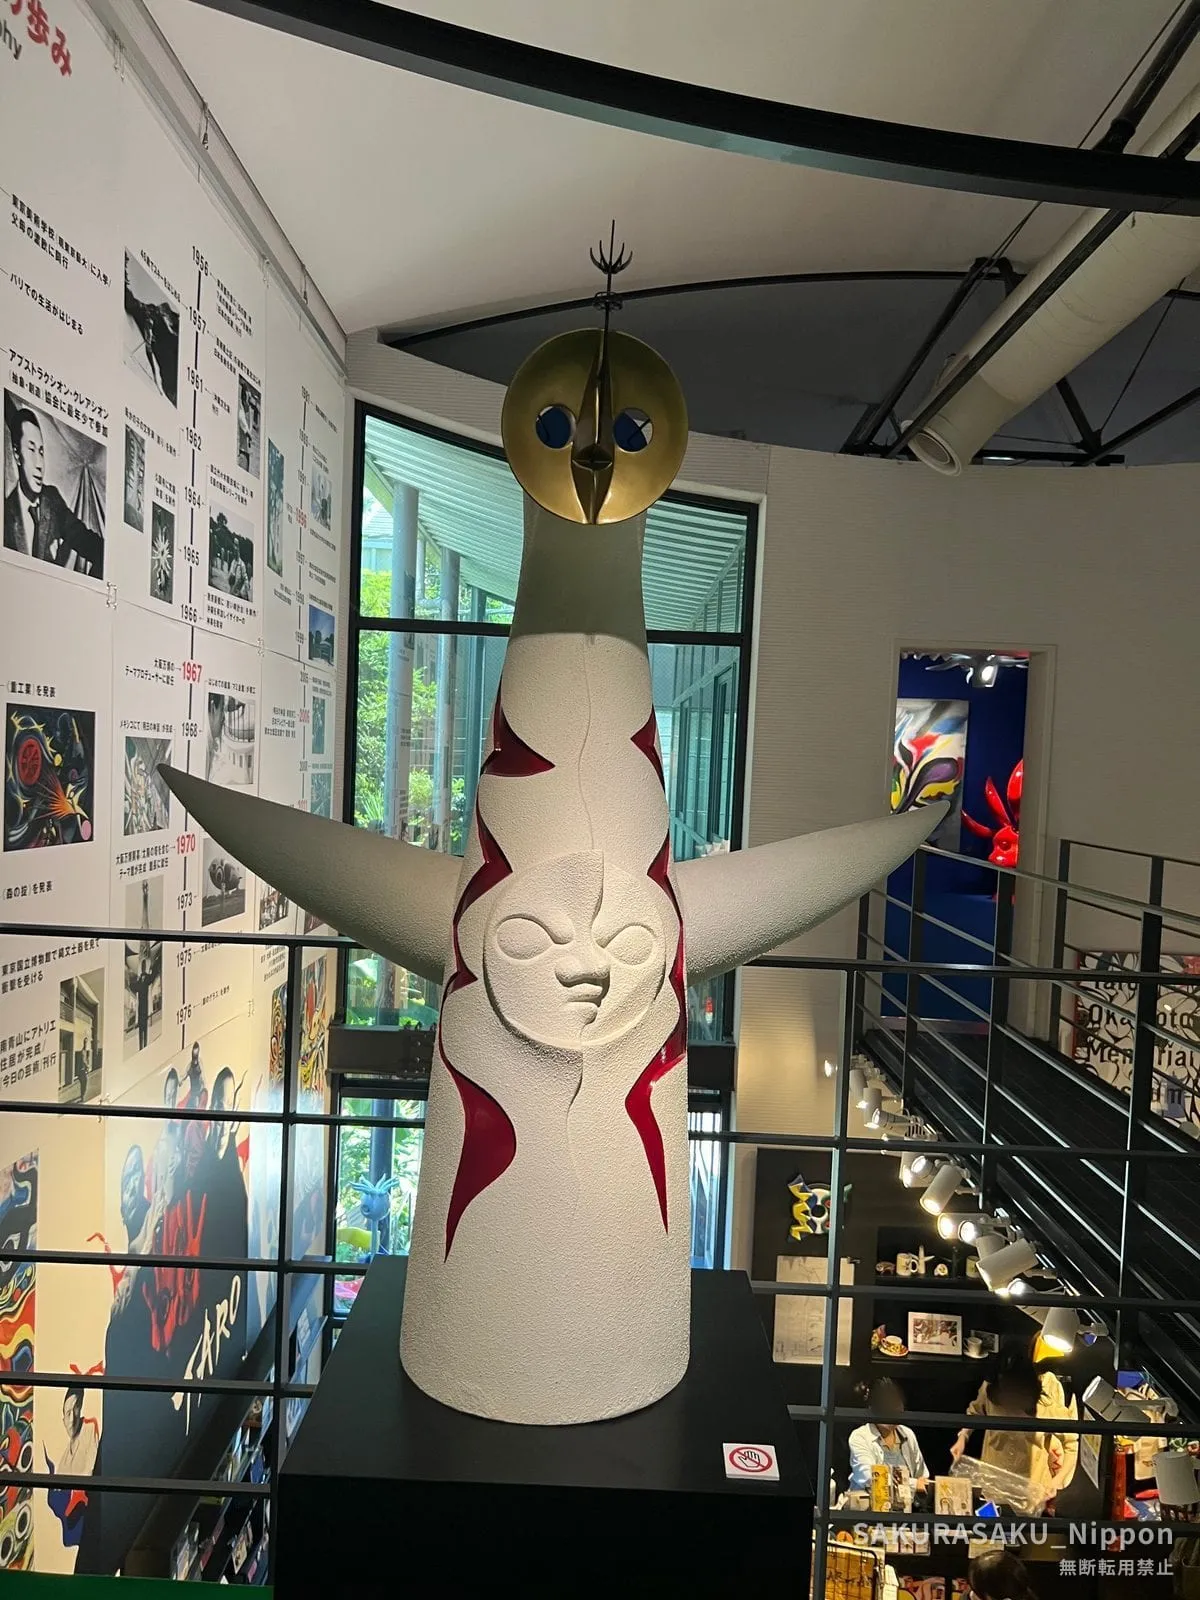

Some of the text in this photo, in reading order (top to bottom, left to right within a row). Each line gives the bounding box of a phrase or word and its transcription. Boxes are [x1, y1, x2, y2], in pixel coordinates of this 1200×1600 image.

[0, 18, 22, 60] hy
[192, 246, 209, 276] 1956
[10, 273, 84, 335] パリでの生活がはじまる
[189, 306, 207, 334] 1957
[187, 366, 203, 393] 1961
[186, 426, 202, 452] 1962
[184, 486, 201, 509] 1964
[183, 545, 200, 566] 1965
[181, 604, 197, 623] 1966
[182, 661, 202, 683] 1967
[182, 722, 198, 738] 1968
[176, 833, 196, 855] 1970
[177, 892, 193, 911] 1973
[176, 948, 192, 967] 1975
[176, 1004, 192, 1025] 1976
